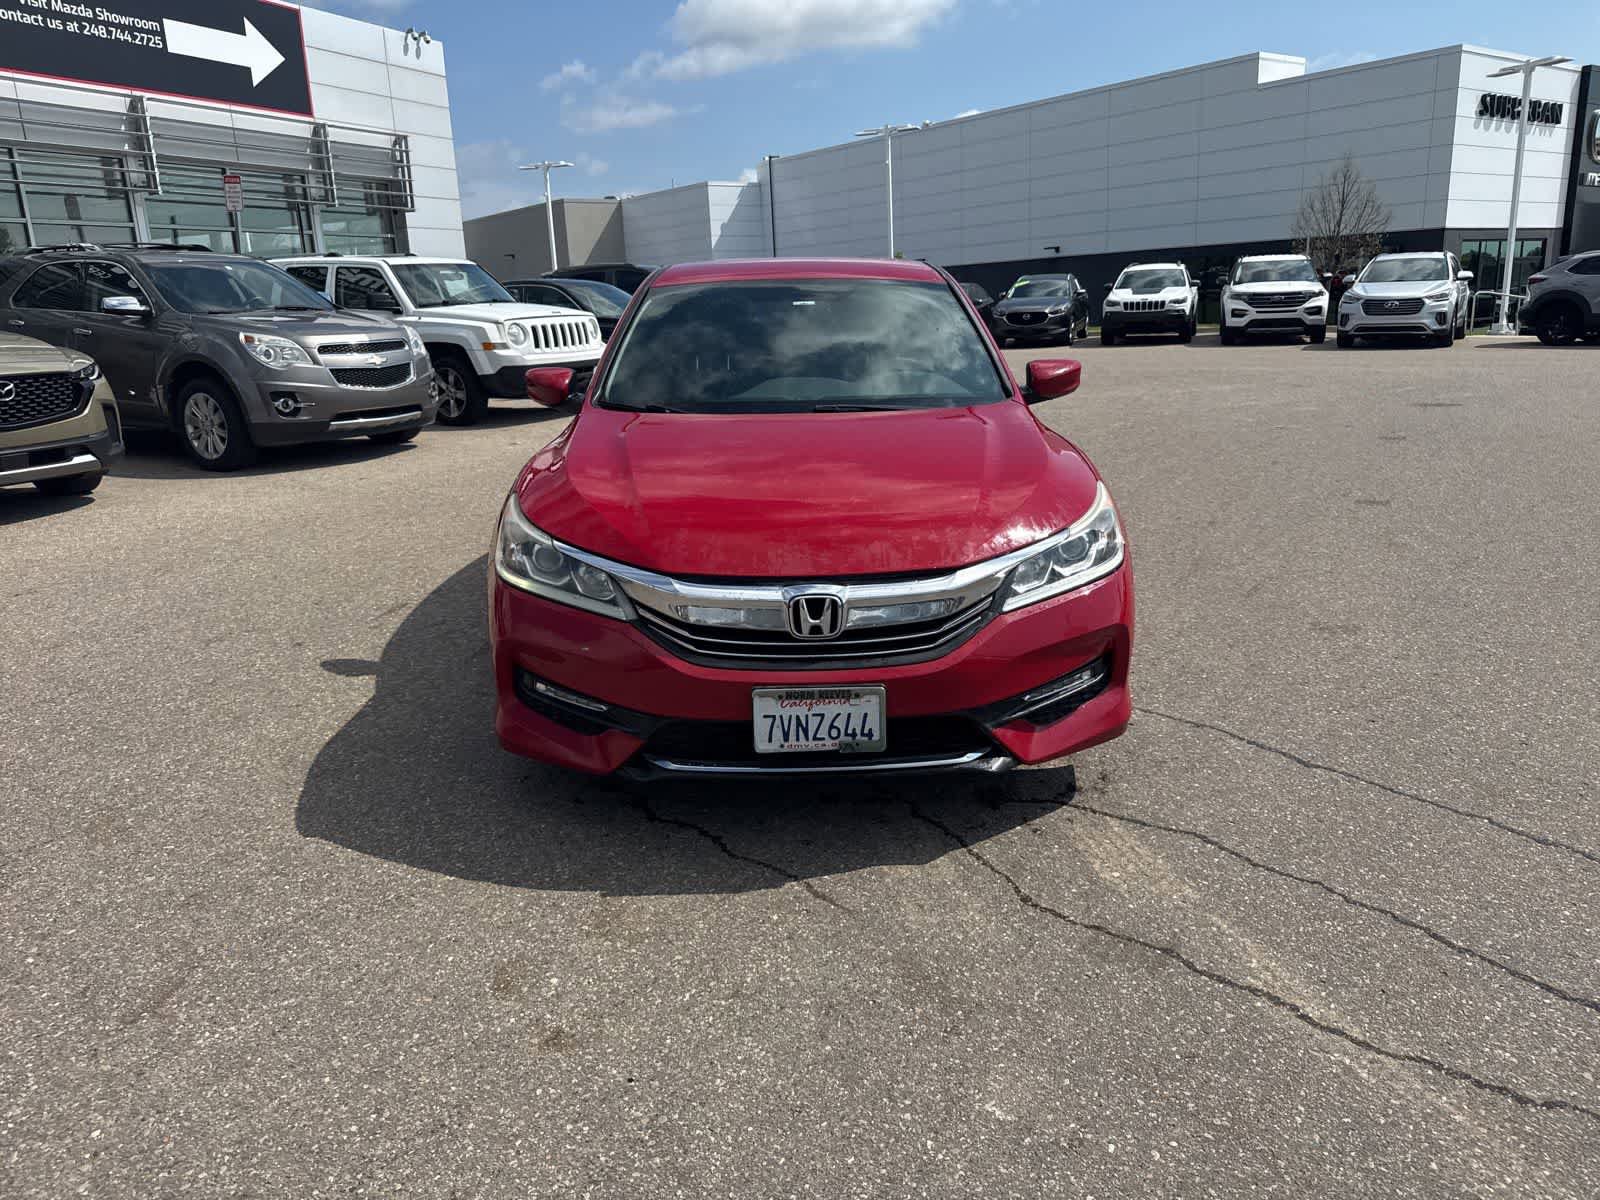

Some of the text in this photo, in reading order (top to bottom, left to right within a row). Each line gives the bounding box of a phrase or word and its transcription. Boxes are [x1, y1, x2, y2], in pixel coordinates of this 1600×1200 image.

[51, 0, 93, 18] Mazda
[96, 8, 161, 31] Showroom
[47, 18, 63, 30] us
[67, 21, 81, 33] at
[82, 22, 163, 49] 248.744.2725
[780, 698, 851, 711] California
[763, 712, 874, 743] 7VNZ644
